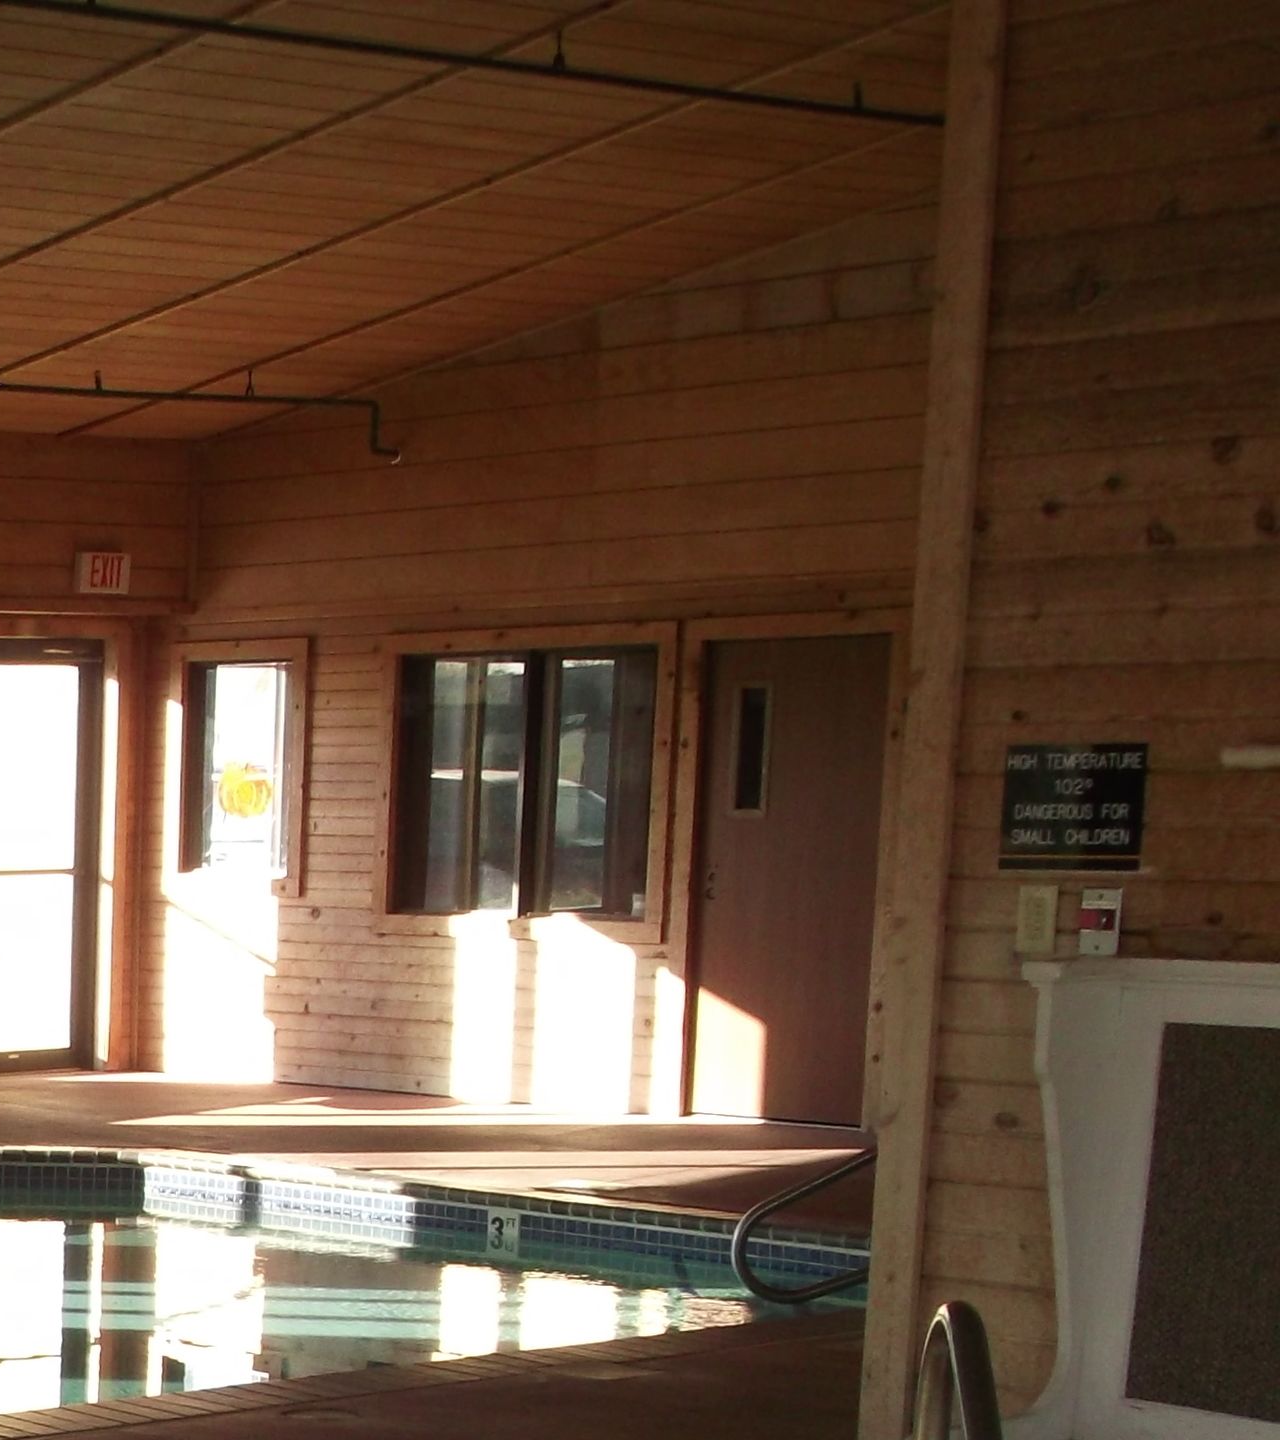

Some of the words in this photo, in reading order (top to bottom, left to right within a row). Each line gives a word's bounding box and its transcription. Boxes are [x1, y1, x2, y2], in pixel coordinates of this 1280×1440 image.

[90, 554, 125, 588] EXIT
[1007, 753, 1038, 769] HIGH
[1047, 752, 1144, 769] TEMPERATURE
[1013, 803, 1094, 820] DANGEROUS
[1101, 803, 1130, 819] FOR
[1010, 829, 1056, 845] SMALL
[1064, 829, 1130, 845] CHILDREN
